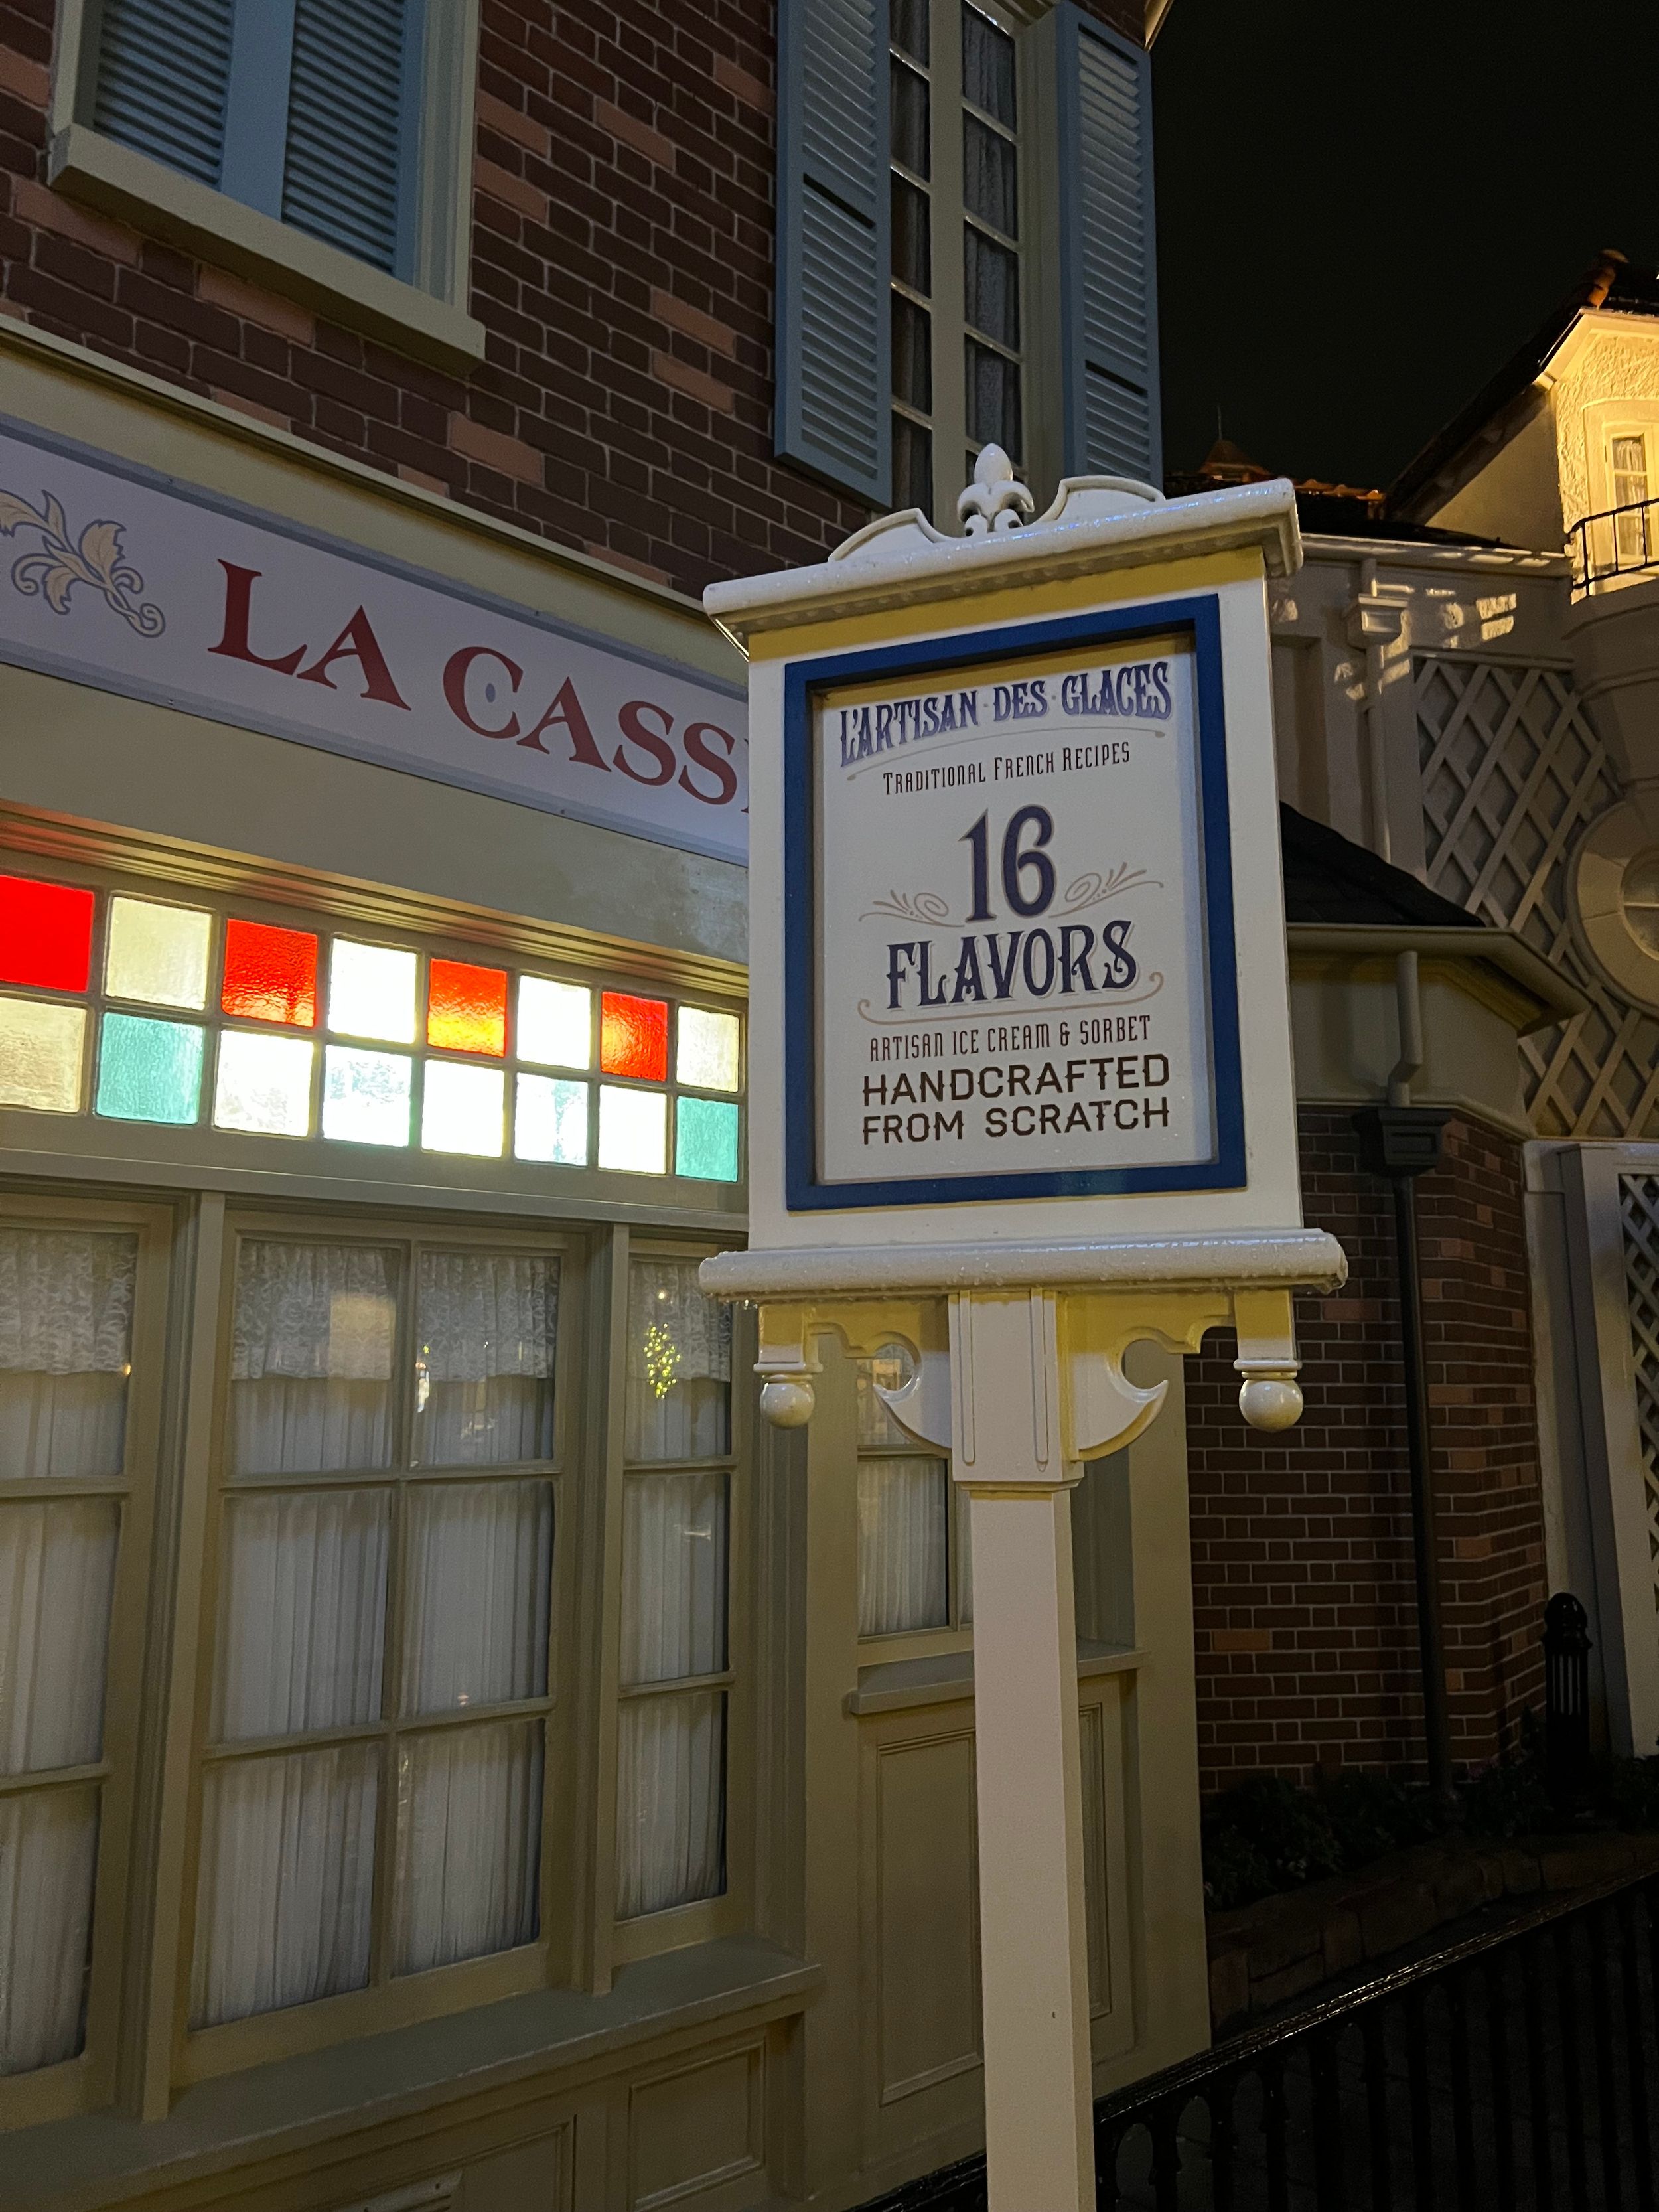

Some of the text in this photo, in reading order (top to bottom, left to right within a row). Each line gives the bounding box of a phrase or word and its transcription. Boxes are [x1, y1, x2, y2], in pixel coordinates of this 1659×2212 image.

[207, 559, 749, 813] LA CASS
[840, 662, 1172, 767] L'ARTISAN DES GLACES
[883, 742, 1129, 795] TRADITIONAL FRENCH RECIPES
[958, 804, 1056, 923] 16
[886, 921, 1137, 1009] FLAVORS
[870, 1015, 1151, 1061] ARTISAN ICE CREAM & SORBET
[863, 1053, 1170, 1106] HANDCRAFTED
[863, 1096, 1169, 1145] FROM SCRATCH
